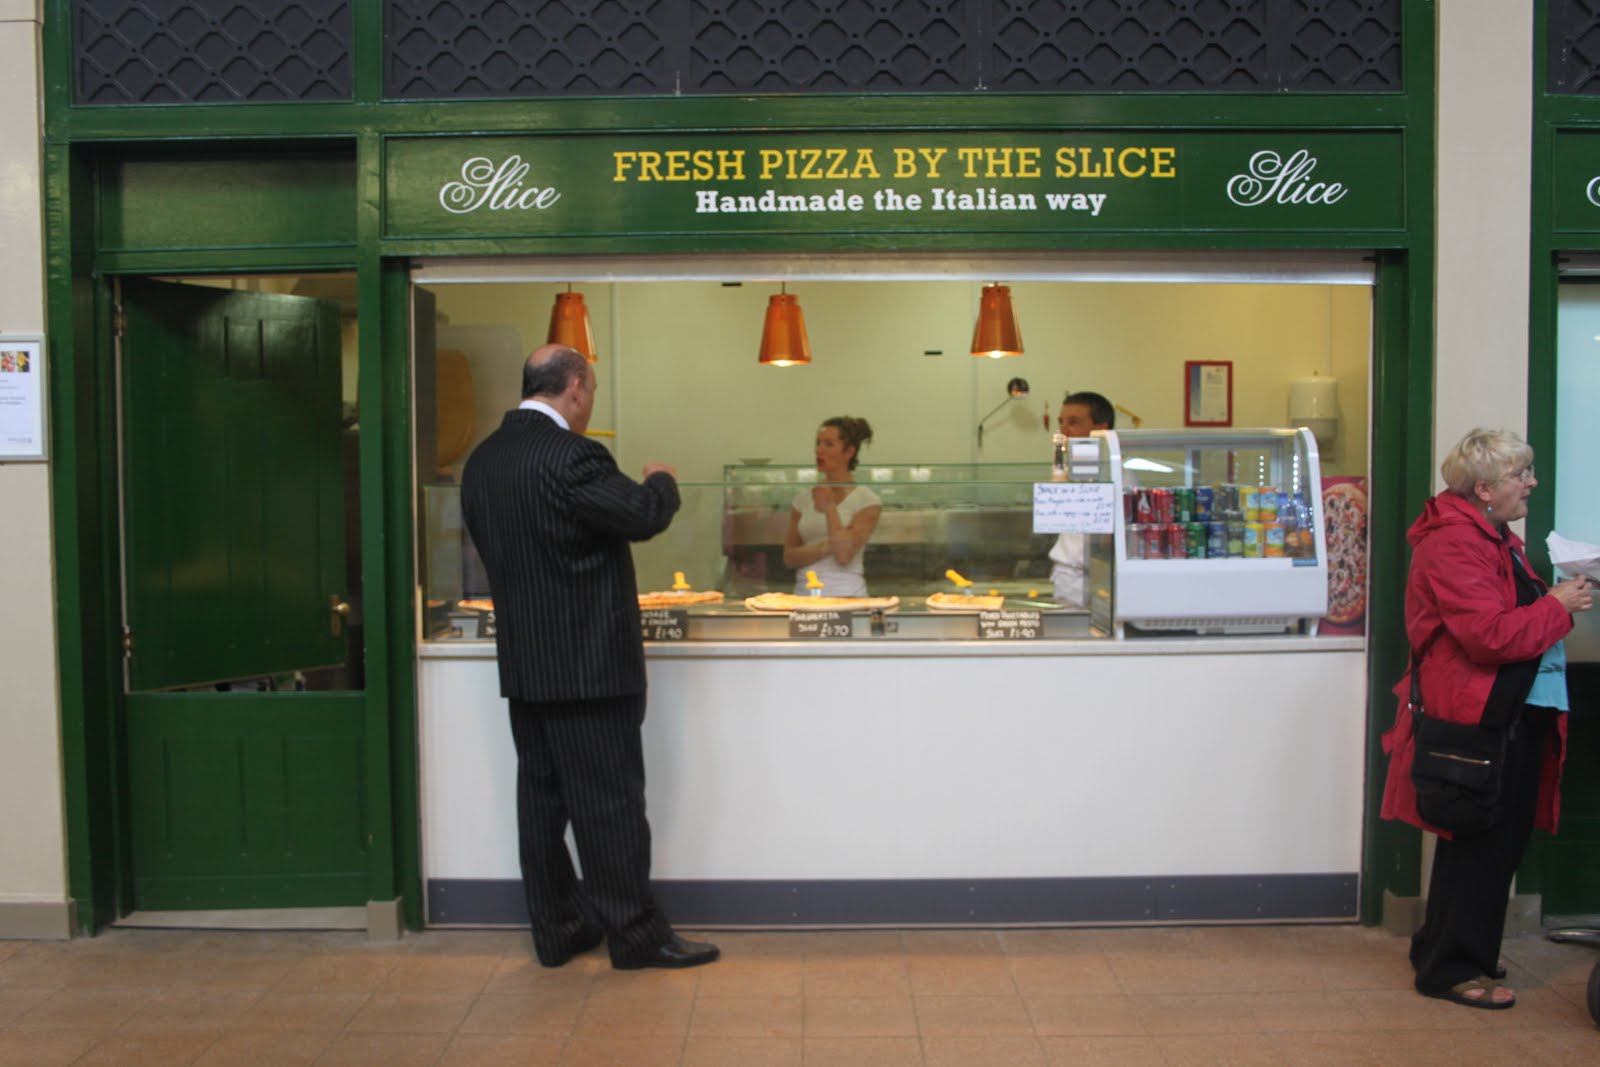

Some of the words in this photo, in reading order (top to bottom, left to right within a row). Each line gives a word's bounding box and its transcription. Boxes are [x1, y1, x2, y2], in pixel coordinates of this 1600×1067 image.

[438, 154, 562, 214] Slice
[613, 149, 747, 183] FRESH
[759, 148, 882, 181] PIZZA
[893, 147, 949, 180] BY
[957, 147, 1042, 179] THE
[1055, 147, 1177, 179] SLICE
[1226, 149, 1349, 207] Slice
[695, 188, 865, 214] Handmade
[873, 188, 923, 212] the
[931, 187, 1038, 211] Italian
[1045, 193, 1107, 217] way
